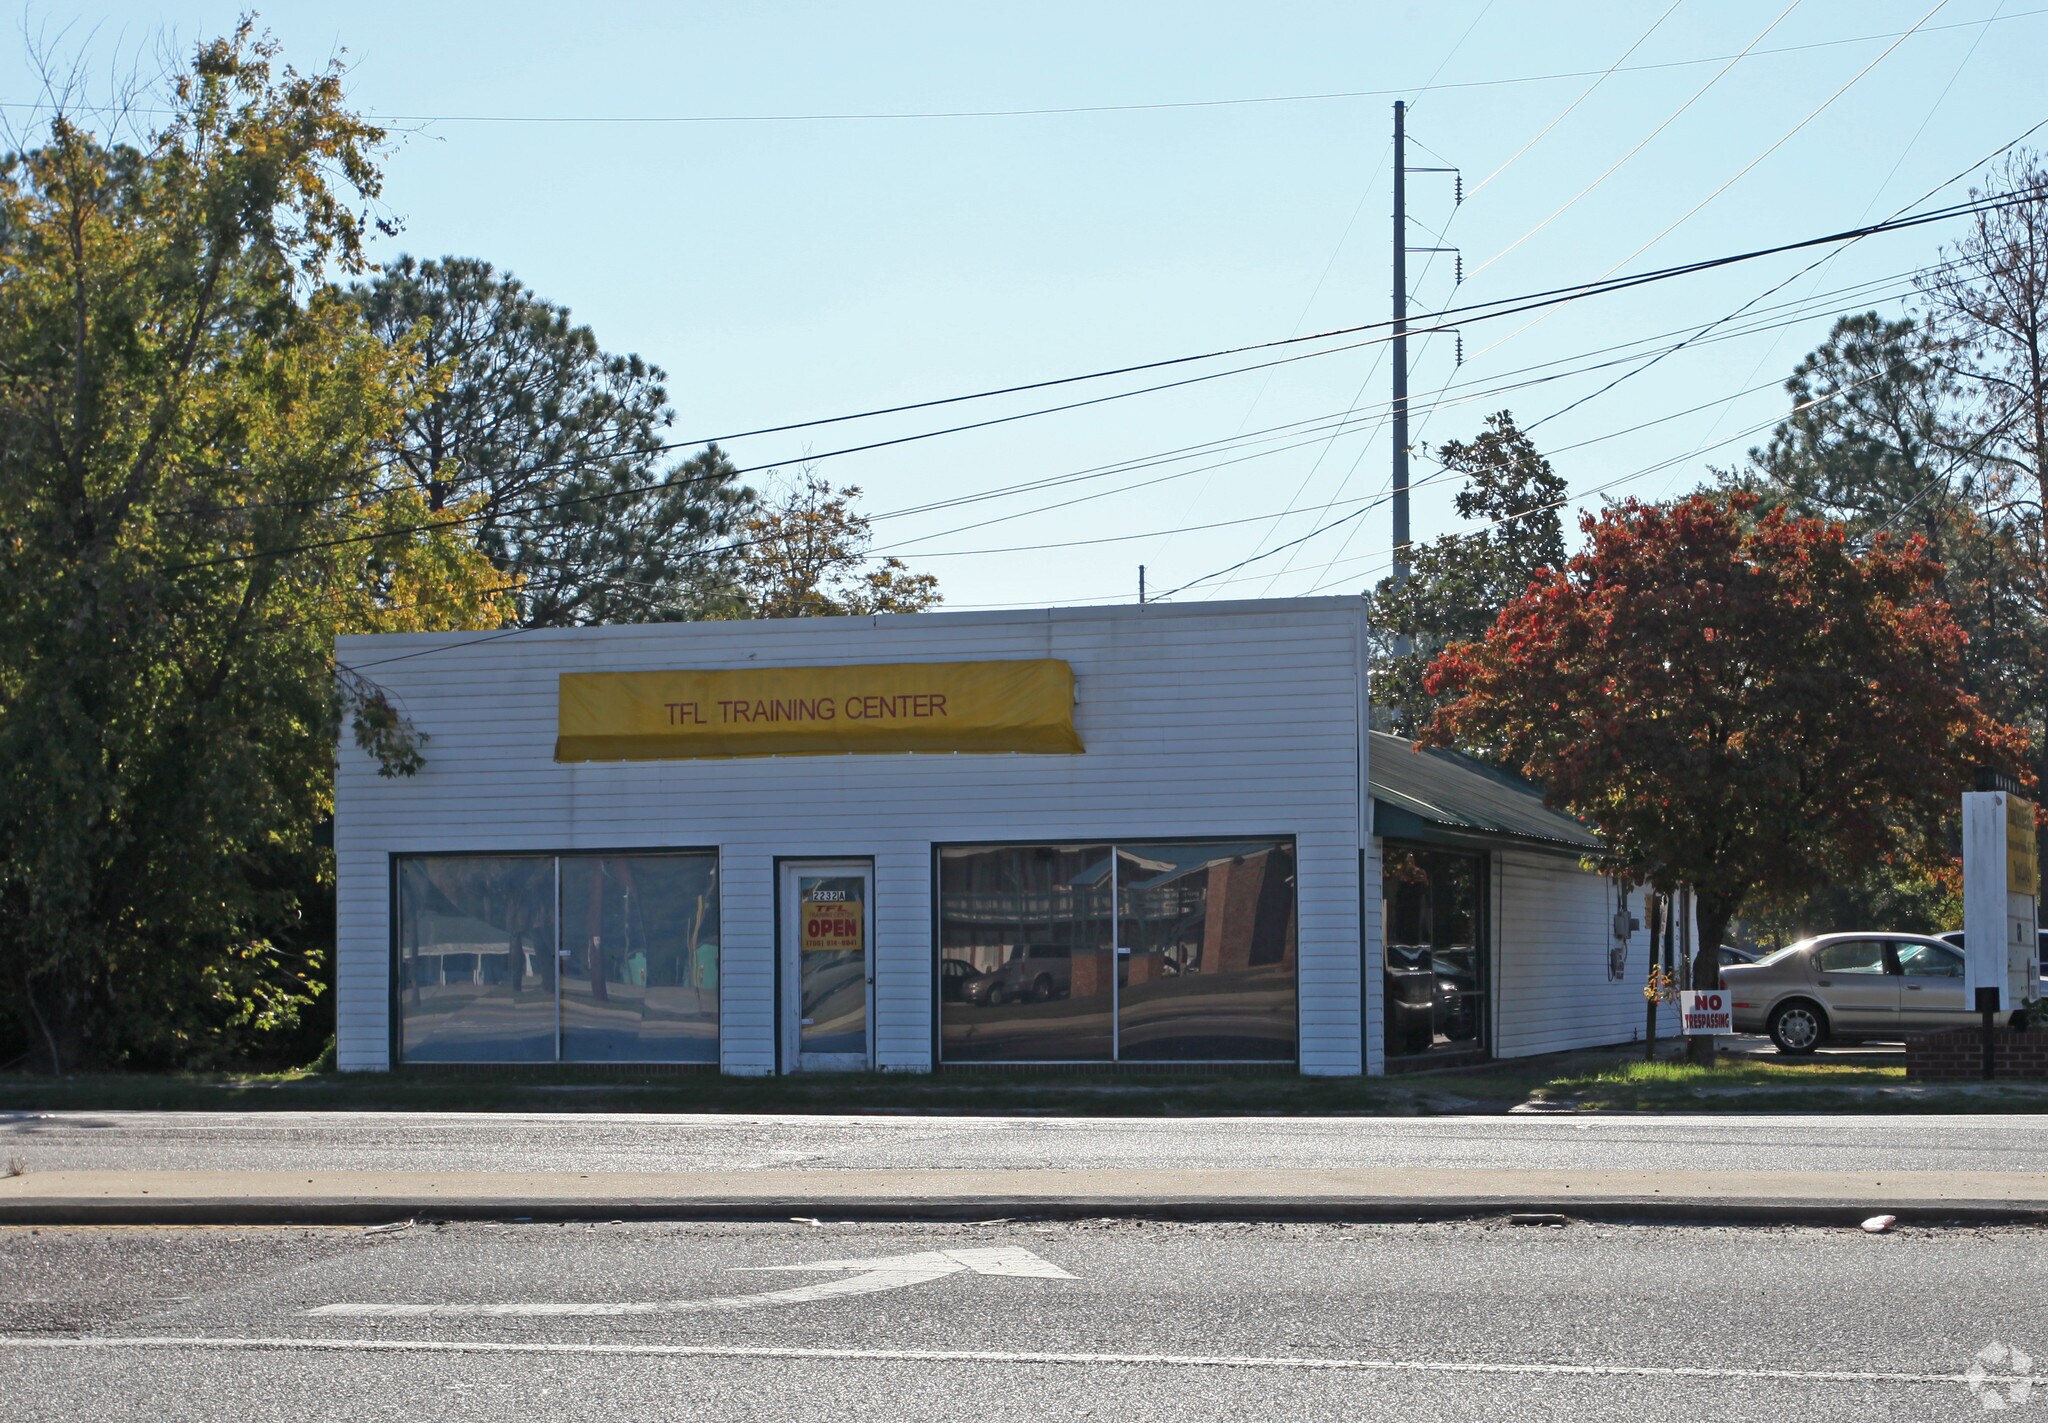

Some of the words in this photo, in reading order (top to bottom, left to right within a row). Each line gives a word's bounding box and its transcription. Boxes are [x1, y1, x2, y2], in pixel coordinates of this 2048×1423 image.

[664, 703, 707, 725] TFL
[717, 698, 836, 723] TRAINING
[845, 694, 947, 720] CENTER
[808, 919, 856, 937] OPEN
[1694, 994, 1722, 1011] NO
[1685, 1012, 1729, 1029] TRESPASSING
